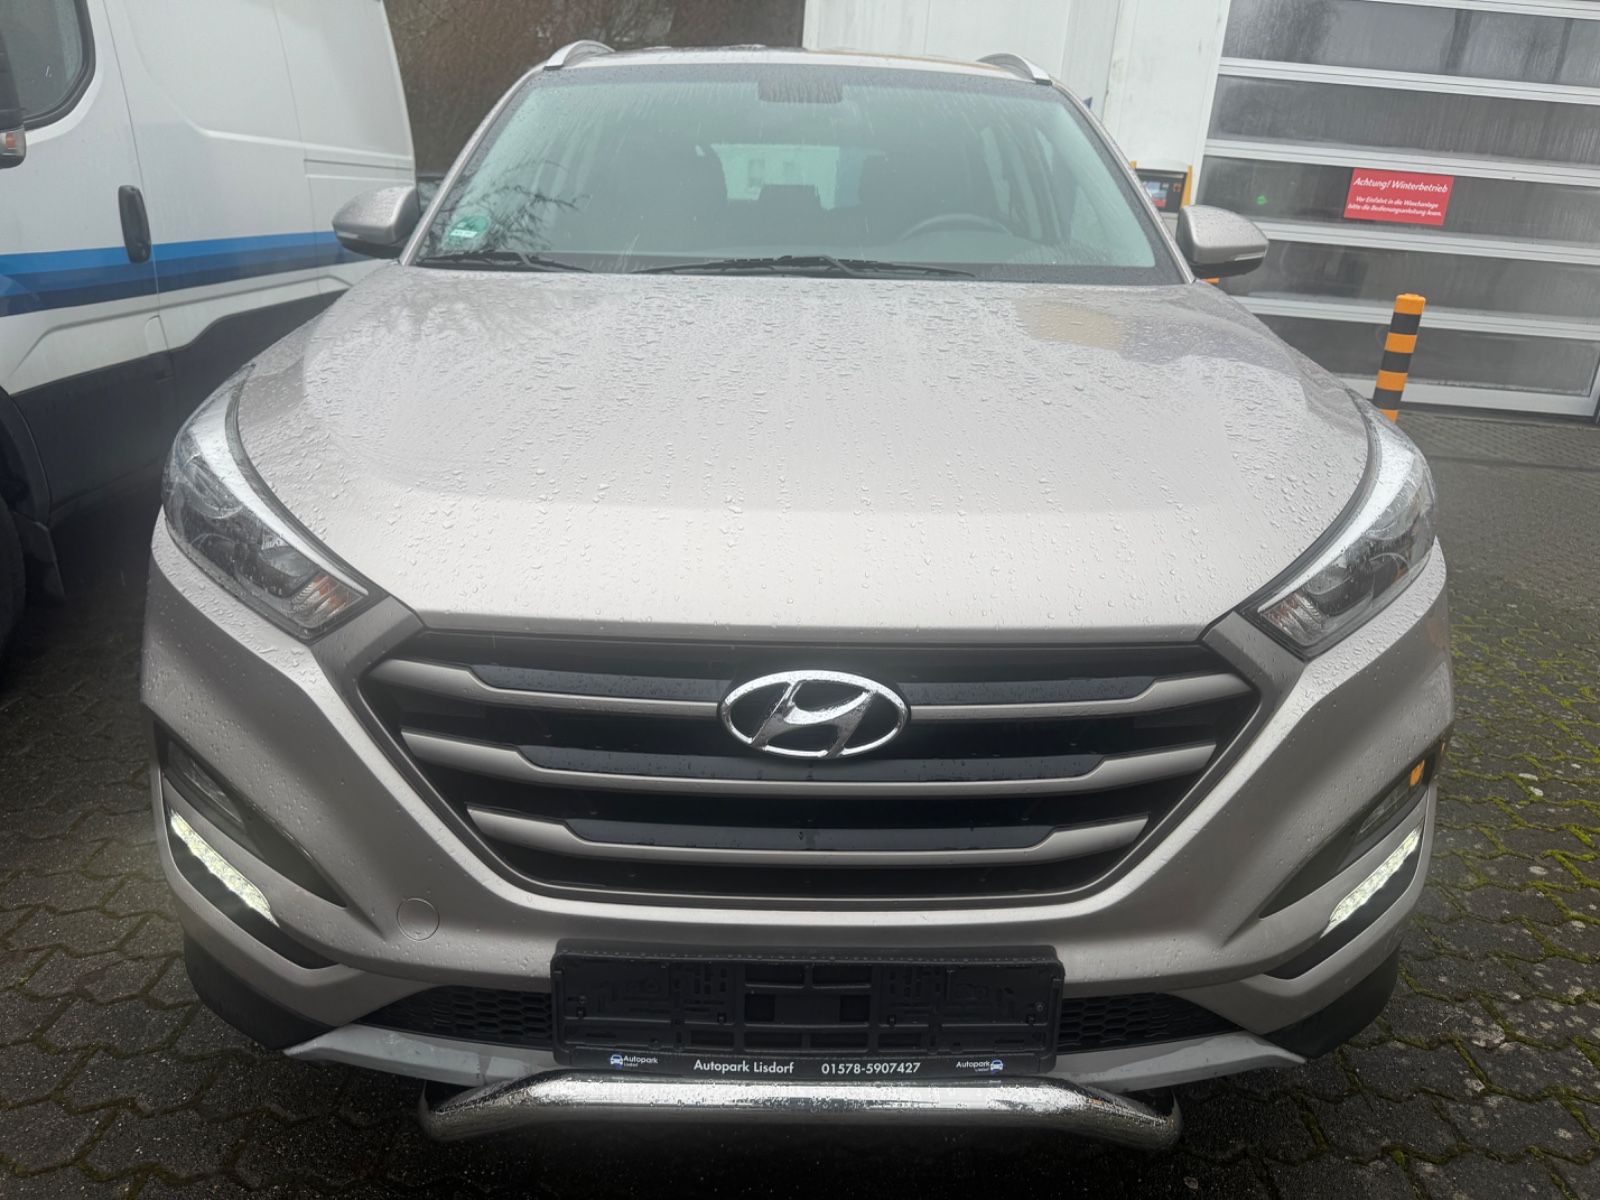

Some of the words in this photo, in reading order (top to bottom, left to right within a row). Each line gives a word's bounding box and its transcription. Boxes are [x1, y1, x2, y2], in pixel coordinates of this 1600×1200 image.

[1353, 177, 1391, 190] Achtung!
[1392, 180, 1448, 193] Winterbetrieb
[623, 1055, 659, 1065] Autopark
[693, 1059, 750, 1074] Autopark
[753, 1062, 794, 1074] Lisdorf
[956, 1060, 991, 1069] Autopark
[821, 1062, 921, 1075] 01578-5907427
